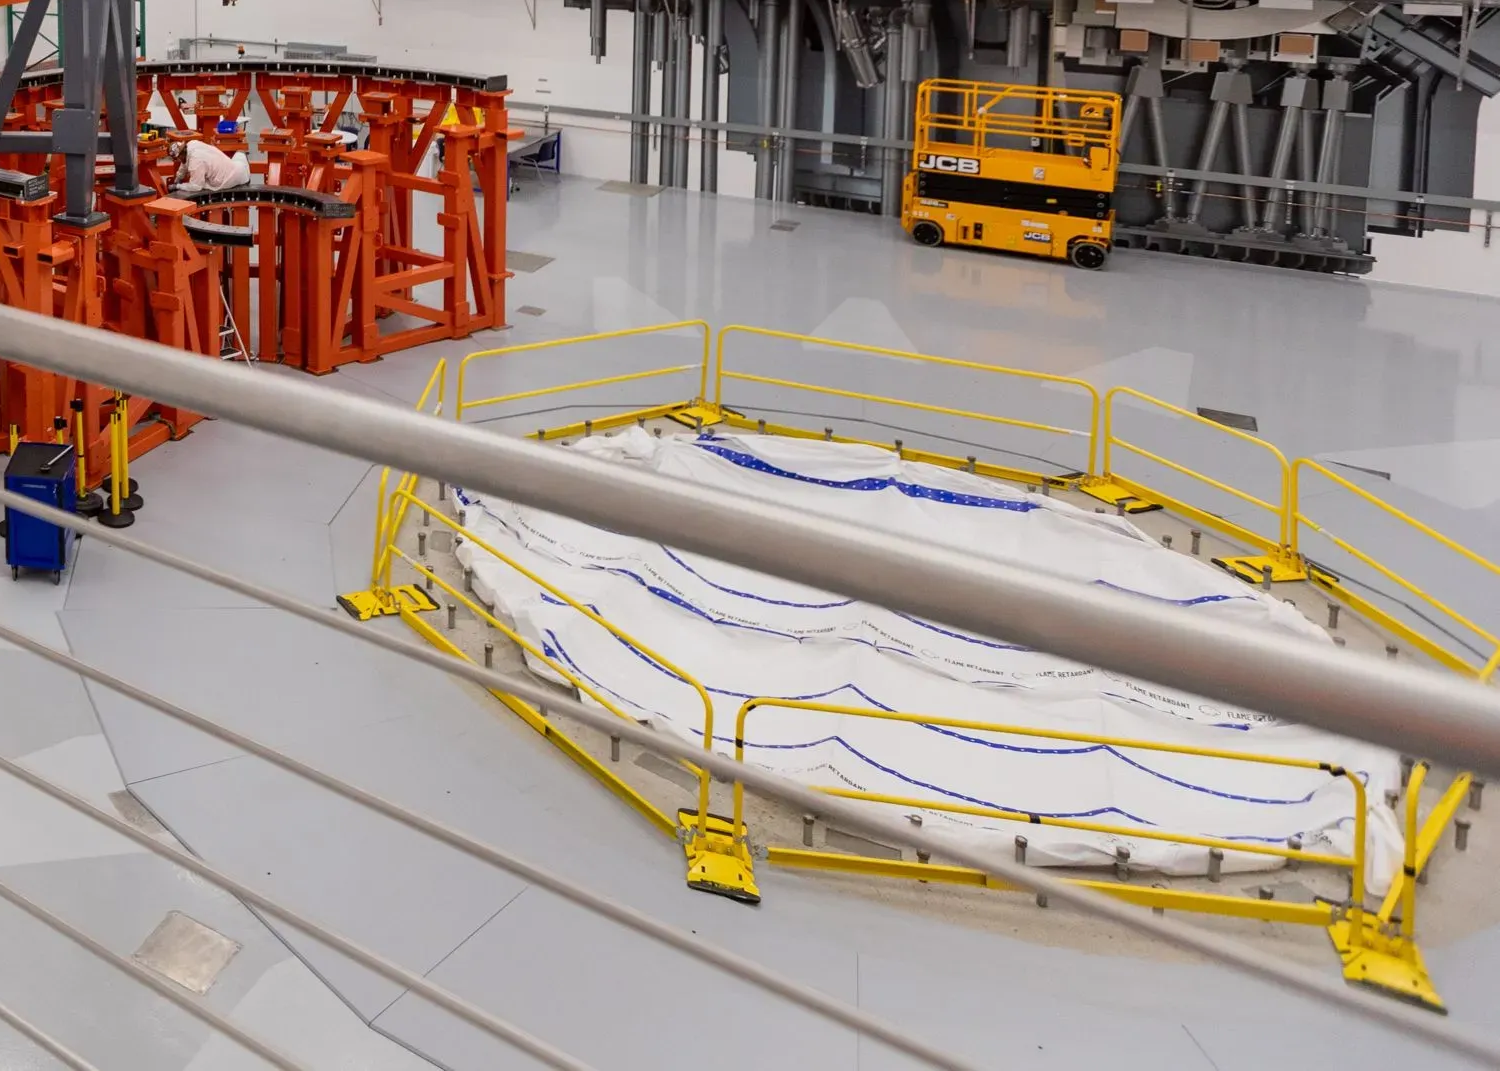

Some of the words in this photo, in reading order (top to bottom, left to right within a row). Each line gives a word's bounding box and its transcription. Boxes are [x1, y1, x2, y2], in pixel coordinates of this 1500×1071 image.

[919, 154, 979, 173] JCB
[1023, 231, 1051, 242] JCB
[1057, 668, 1095, 679] RETARDANT
[1125, 681, 1147, 695] FLAME
[1148, 692, 1190, 709] RETARDANT
[1227, 711, 1251, 721] FLAME
[828, 764, 867, 792] RETARDANT
